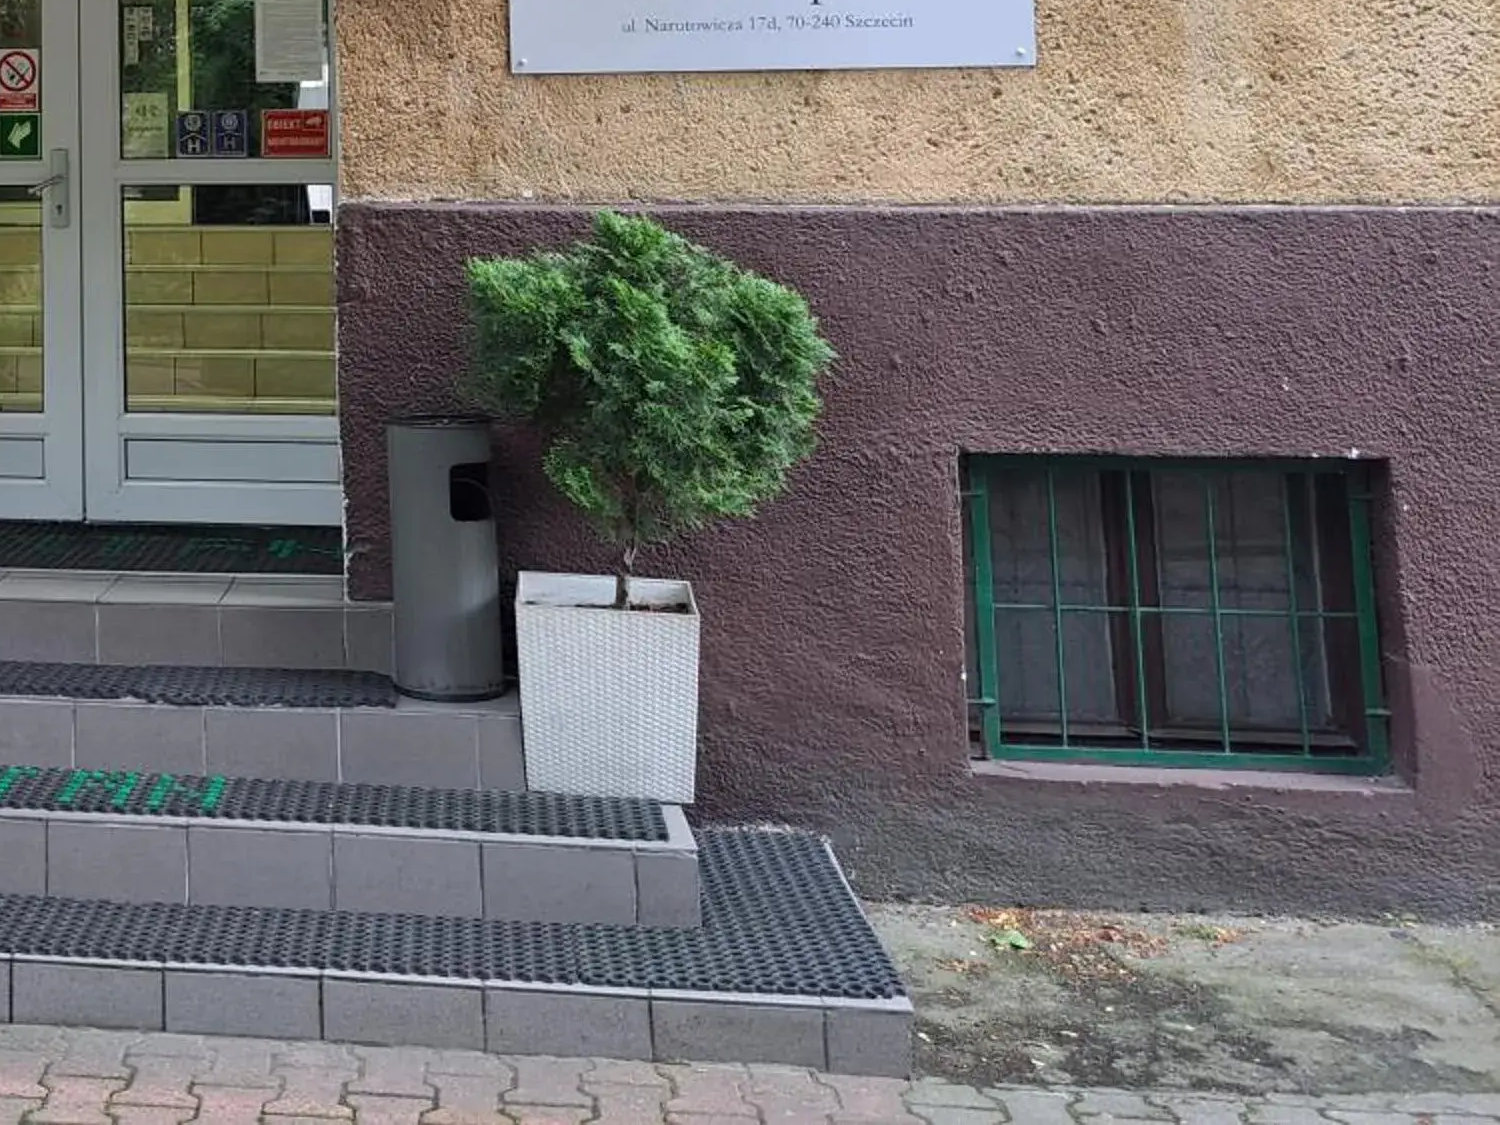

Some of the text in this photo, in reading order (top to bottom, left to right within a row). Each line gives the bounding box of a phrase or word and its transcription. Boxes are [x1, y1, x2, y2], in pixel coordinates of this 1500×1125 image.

[644, 17, 743, 33] Narutowicza
[786, 13, 841, 30] 70-240
[845, 12, 915, 29] Szczecin
